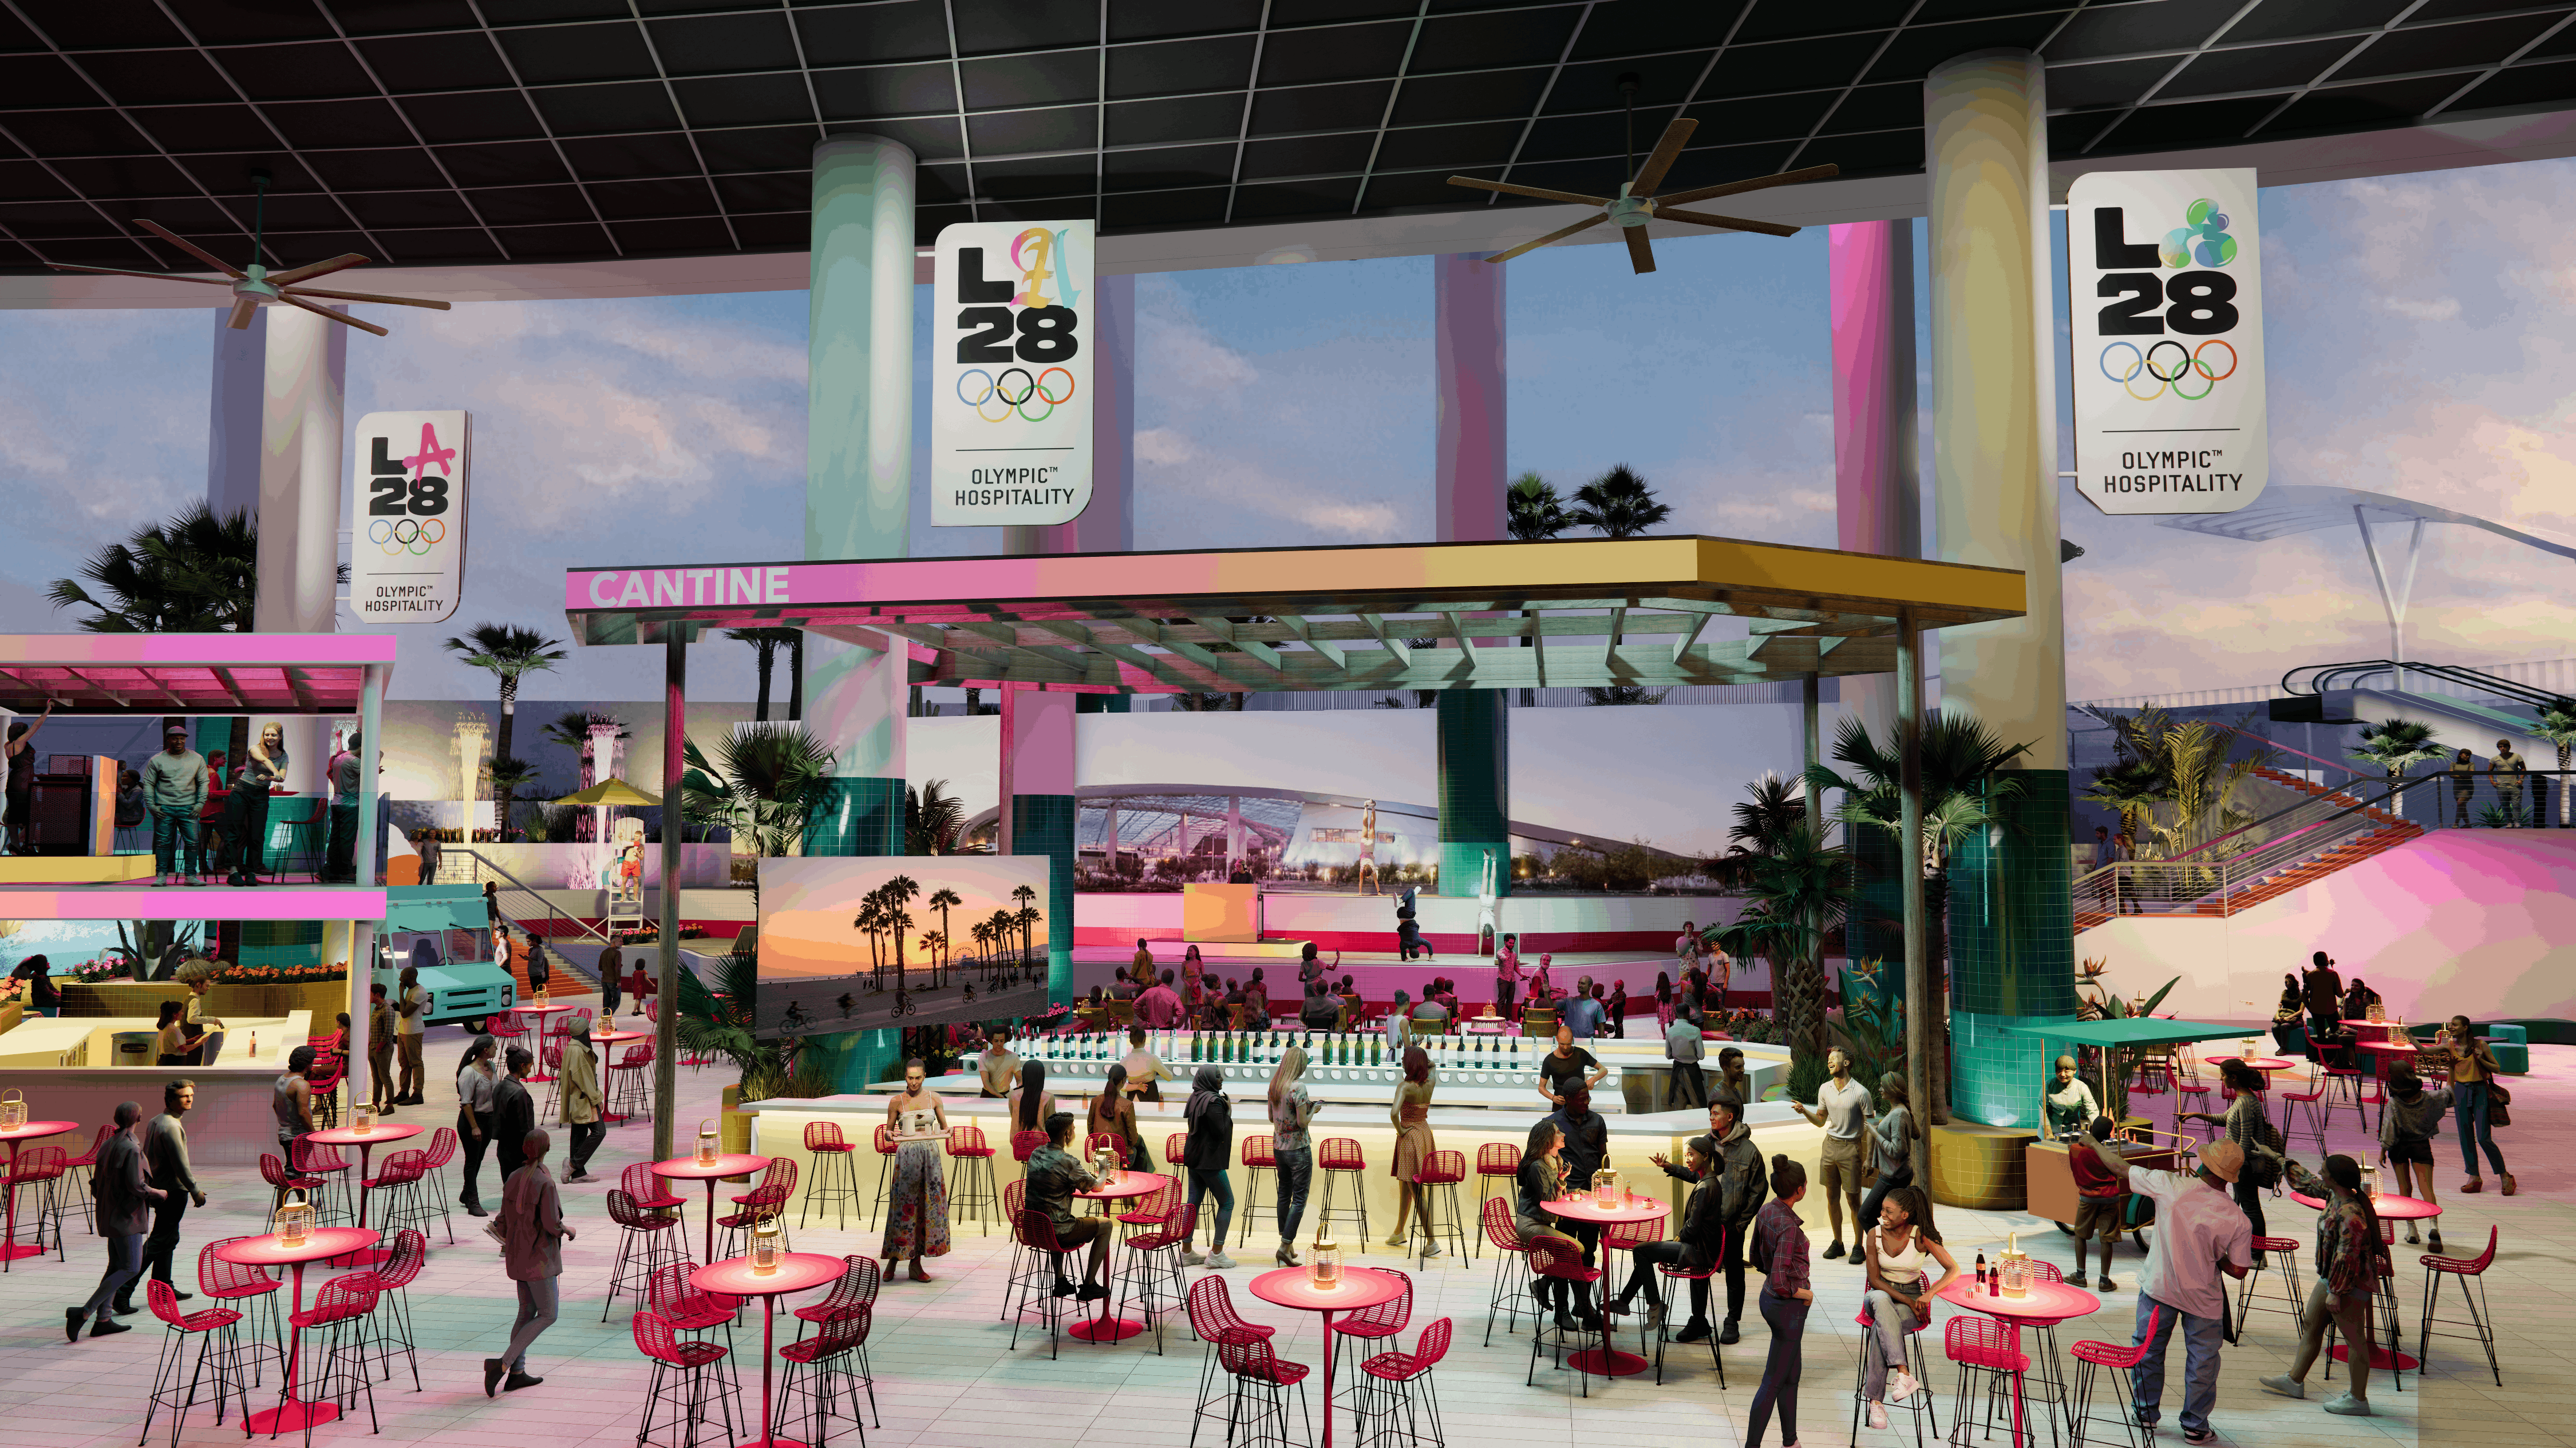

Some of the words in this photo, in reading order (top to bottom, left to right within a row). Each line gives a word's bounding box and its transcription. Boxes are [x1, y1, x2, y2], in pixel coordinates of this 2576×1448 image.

[2097, 270, 2239, 336] 28
[957, 304, 1078, 364] 28
[371, 422, 456, 485] LA
[369, 476, 449, 516] 28
[955, 489, 1074, 506] HOSPITALITY
[2104, 474, 2243, 493] HOSPITALITY
[366, 600, 444, 611] HOSPITALITY
[589, 567, 789, 608] CANTINE
